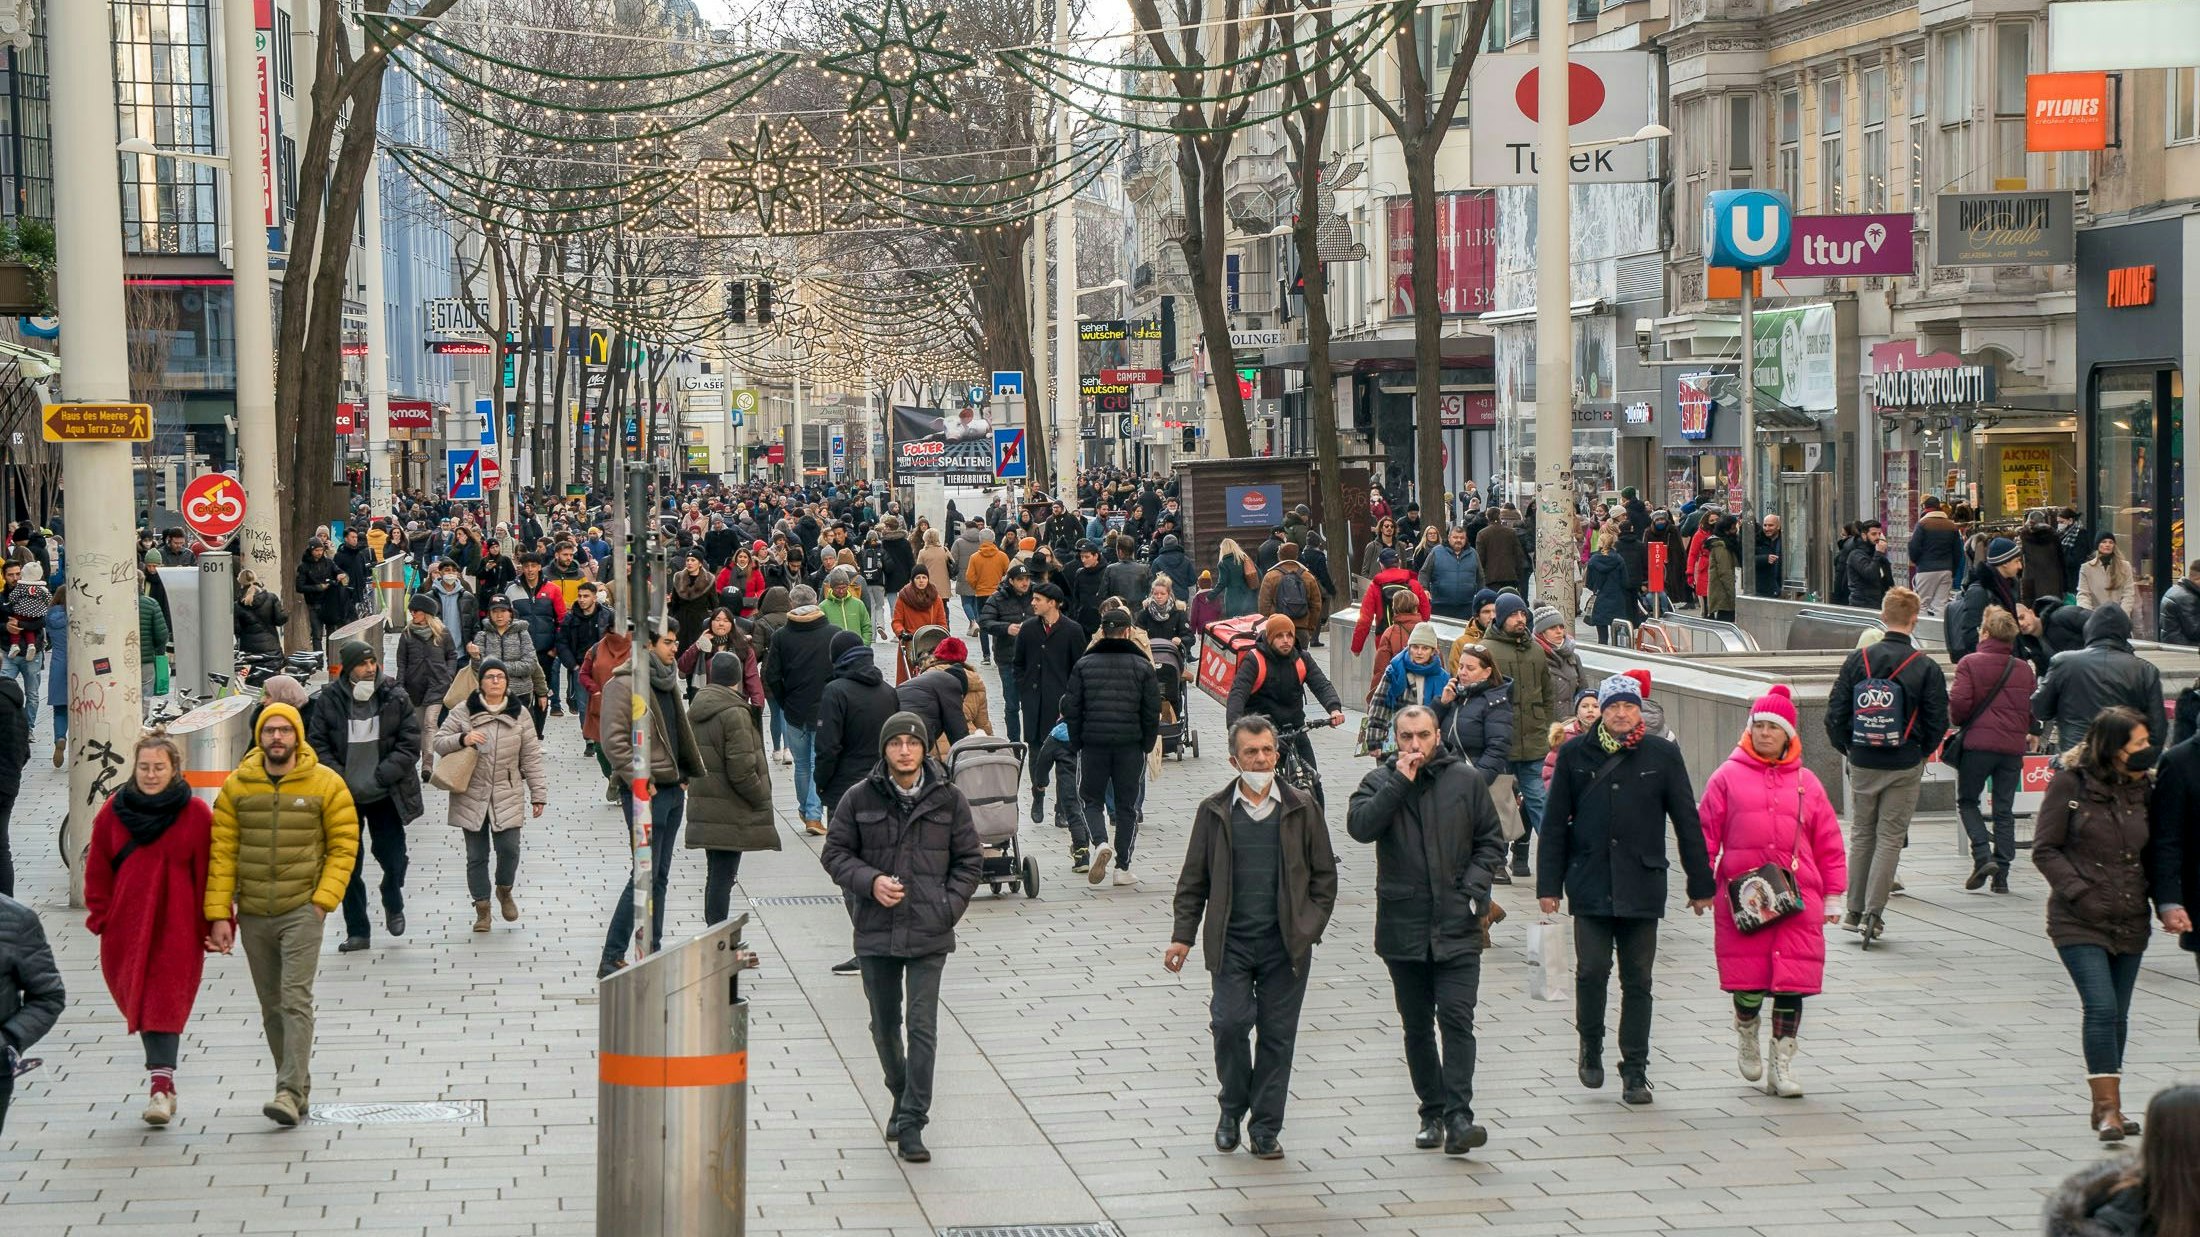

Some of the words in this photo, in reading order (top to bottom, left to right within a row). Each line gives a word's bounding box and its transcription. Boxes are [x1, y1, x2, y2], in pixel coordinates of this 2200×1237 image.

[2035, 98, 2099, 117] PYLONES
[1505, 143, 1614, 174] Tuek
[1960, 198, 2050, 231] BORTOLOTTI
[1732, 206, 1780, 256] U
[1968, 211, 2047, 250] Paolo
[1804, 234, 1866, 265] ltur
[2107, 264, 2156, 309] PYLONES
[437, 303, 516, 329] STADTSL
[1081, 323, 1109, 333] sehen!
[1081, 331, 1125, 340] wutscher
[1116, 372, 1147, 382] CAMPER
[1082, 386, 1129, 394] wutscher
[1873, 371, 1908, 407] PAOLO
[1911, 366, 1985, 406] BORTOLOTTI
[972, 389, 983, 402] U
[61, 411, 81, 420] Haus
[83, 411, 97, 420] des
[100, 411, 128, 420] Meeres
[65, 424, 85, 435] Aqua
[87, 424, 109, 434] Terra
[111, 424, 126, 433] Zoo
[903, 442, 944, 456] FOLTER
[2003, 449, 2050, 460] AKTION
[2003, 464, 2051, 472] LAMMFELL
[947, 474, 992, 484] TIERFABRIKEN
[198, 505, 232, 514] citybike
[203, 562, 224, 573] 601
